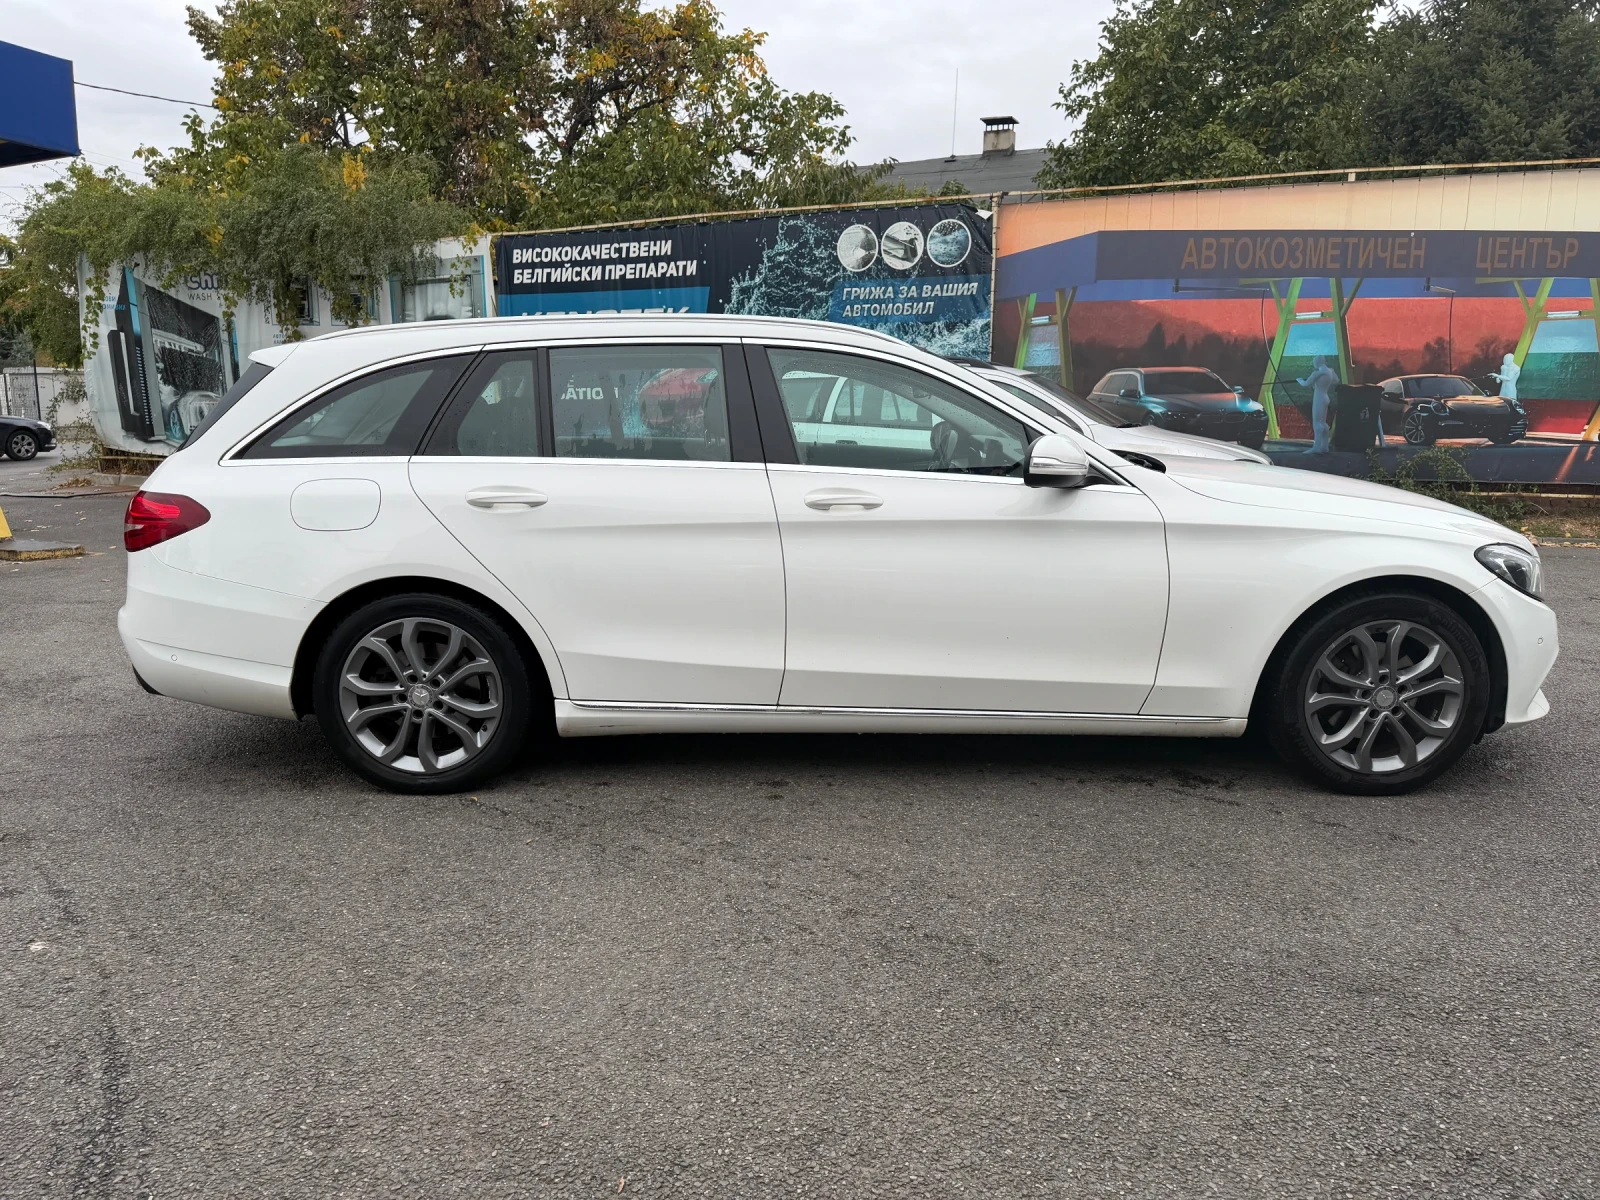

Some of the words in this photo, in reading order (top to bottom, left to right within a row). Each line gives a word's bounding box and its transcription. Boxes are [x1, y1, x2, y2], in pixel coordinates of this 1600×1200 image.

[512, 240, 672, 264] ВИСОКОКАЧЕСТВЕНИ
[1181, 237, 1427, 270] АВТОКОЗМЕТИЧЕН
[1475, 236, 1580, 274] ЦЕНТЪР
[513, 264, 602, 284] БЕЛГИЙСКИ
[604, 260, 697, 280] ПРЕПАРАТИ
[187, 292, 213, 301] WASH
[842, 286, 895, 300] ГРИЖА
[898, 285, 918, 298] ЗА
[921, 282, 979, 298] ВАШИЯ
[842, 301, 935, 317] АВТОМОБИЛ
